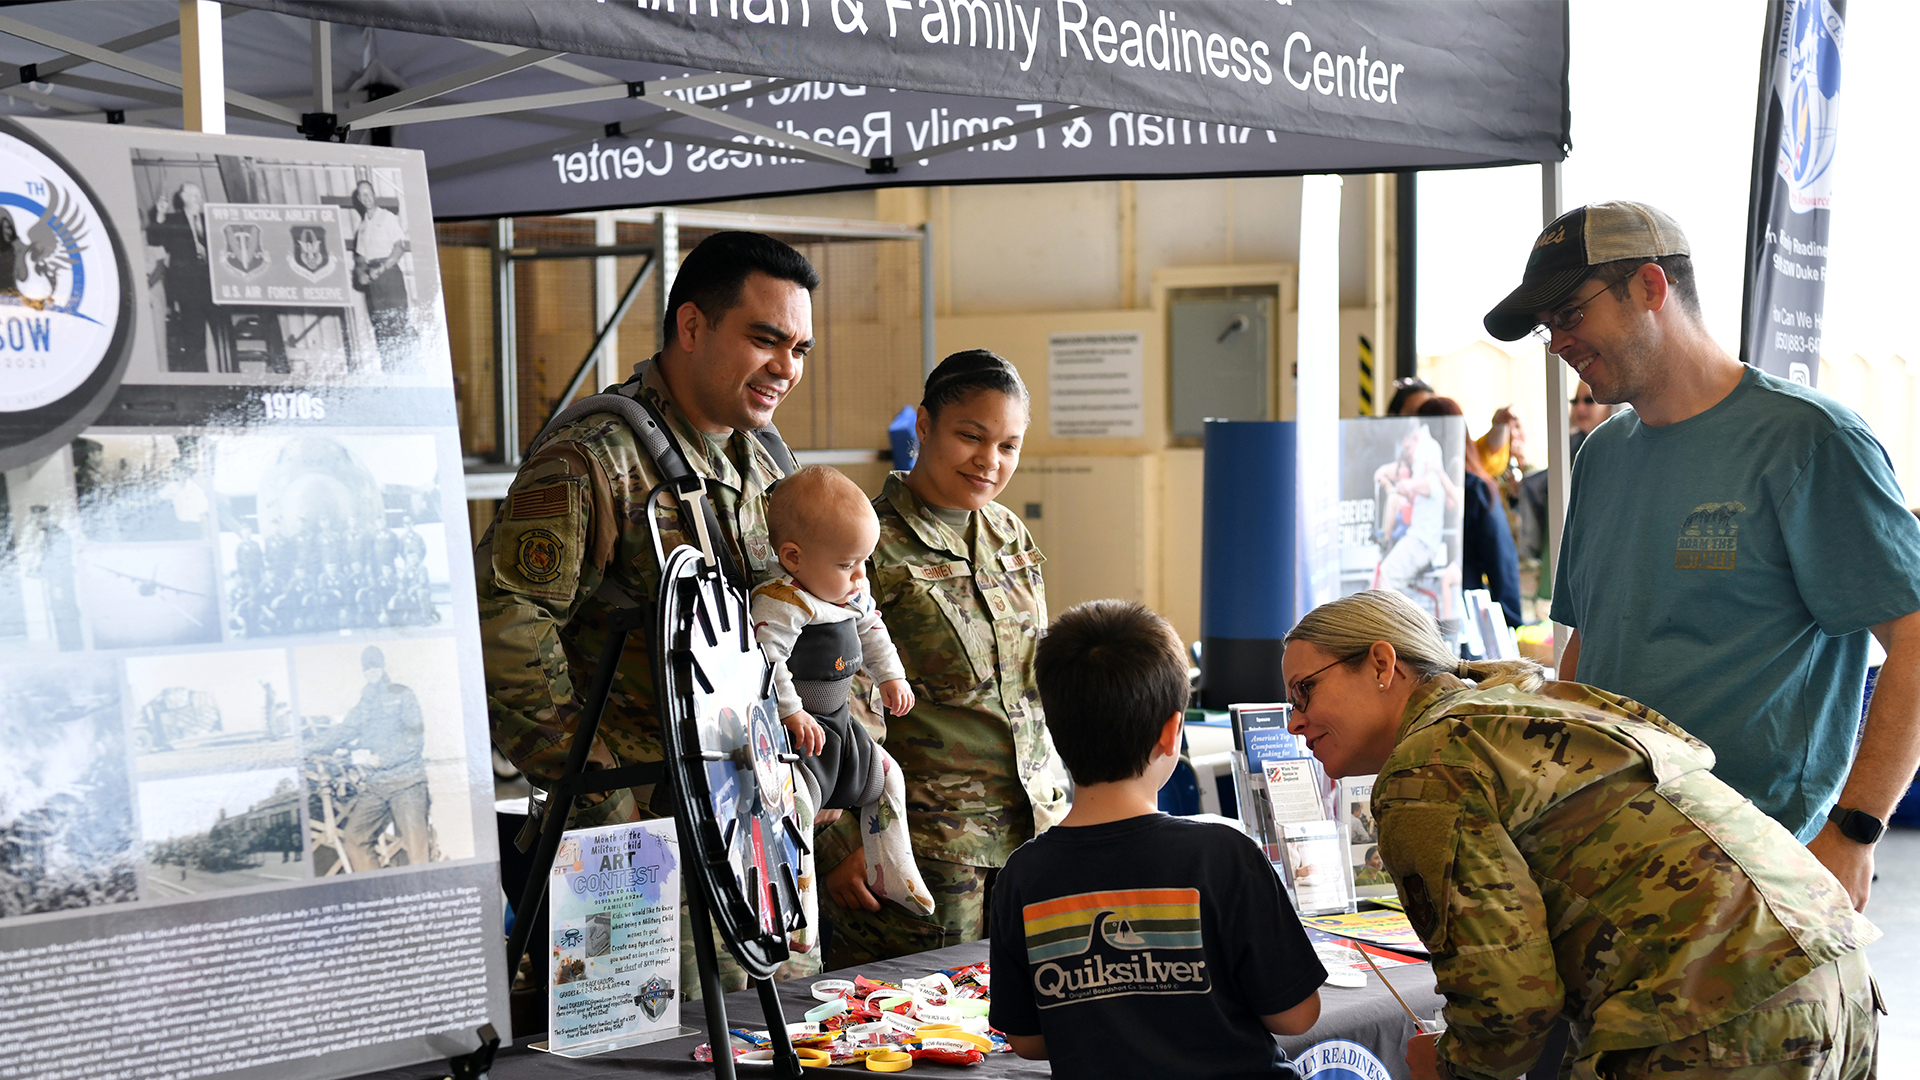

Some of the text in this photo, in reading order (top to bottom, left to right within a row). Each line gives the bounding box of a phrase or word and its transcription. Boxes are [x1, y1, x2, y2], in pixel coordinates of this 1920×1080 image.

[885, 0, 1041, 71] Family
[1056, 0, 1273, 86] Readiness
[1283, 31, 1405, 104] Center
[25, 181, 46, 196] TH
[242, 208, 282, 221] TACTICAL
[1796, 263, 1819, 281] Duke
[244, 285, 262, 298] AIR
[267, 286, 298, 299] FORCE
[302, 287, 343, 300] RESERVE
[1796, 311, 1813, 329] We
[261, 392, 325, 419] 1970s
[1012, 556, 1024, 568] AIR
[1280, 733, 1290, 742] Top
[1281, 750, 1290, 758] for
[594, 831, 641, 844] Month of the
[591, 841, 641, 855] Military Child
[599, 852, 636, 872] ART
[573, 865, 660, 894] CONTEST
[603, 902, 634, 911] FAMILIES!
[625, 921, 637, 929] being
[642, 917, 661, 925] Military
[662, 914, 673, 922] Child
[638, 940, 648, 948] type
[655, 936, 673, 944] artwork
[1034, 952, 1206, 998] Quiksilver
[1069, 989, 1092, 1000] Original
[1092, 984, 1127, 994] Boardshort
[1321, 1047, 1387, 1080] READINES
